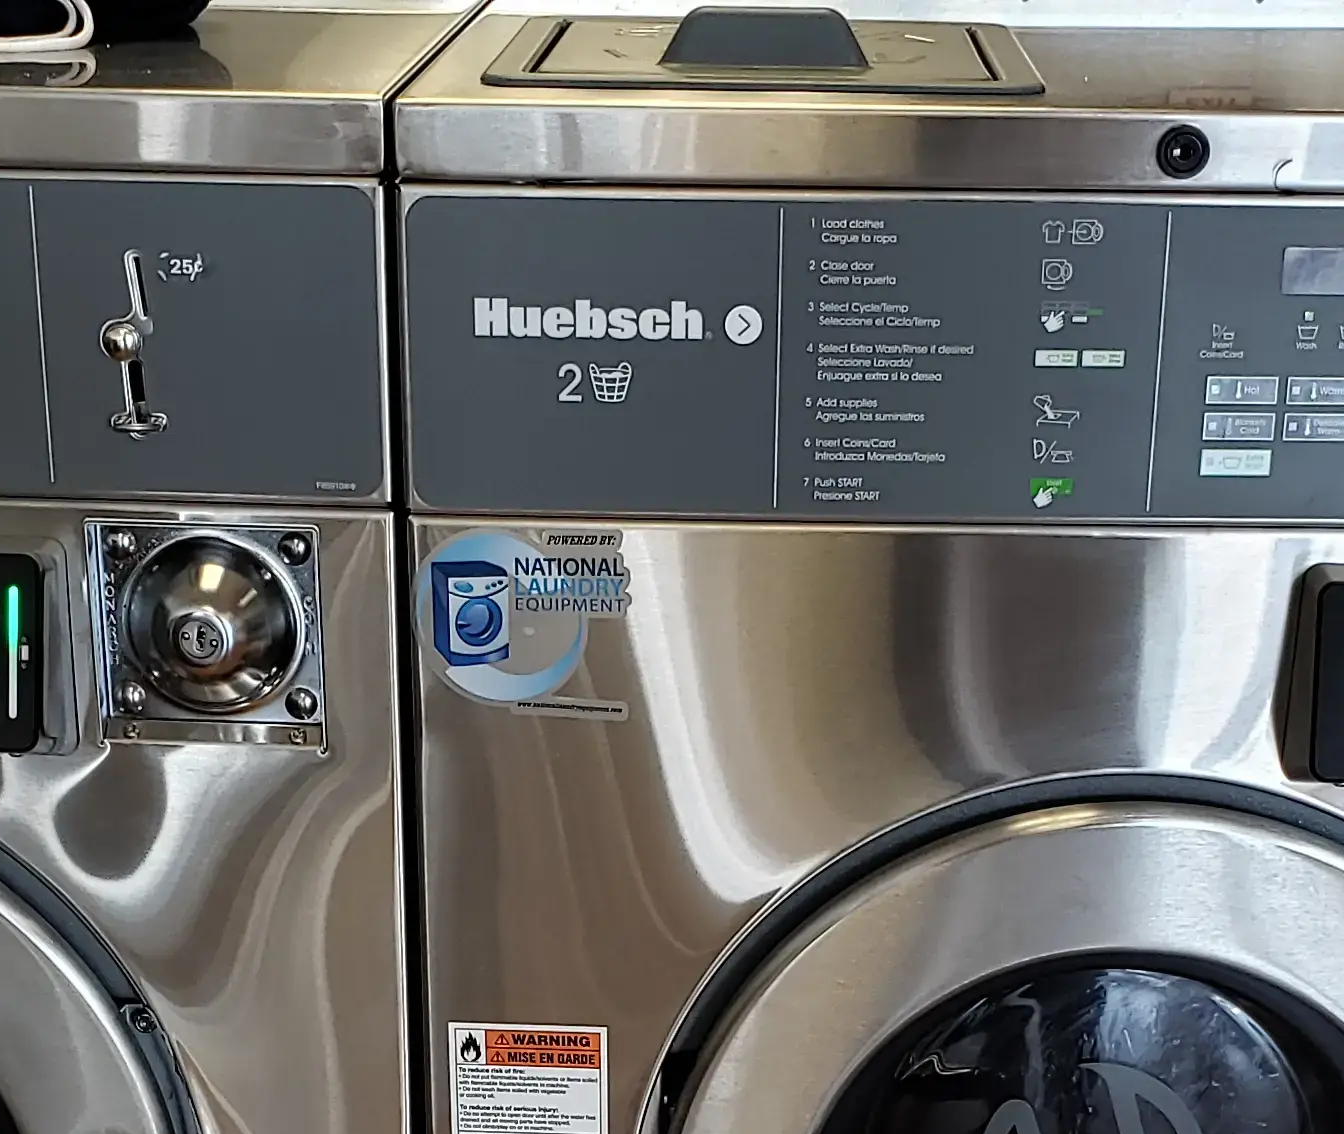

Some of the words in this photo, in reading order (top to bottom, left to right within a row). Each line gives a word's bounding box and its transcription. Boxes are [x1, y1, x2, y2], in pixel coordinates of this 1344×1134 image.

[822, 219, 847, 228] Load
[849, 220, 884, 229] clothes
[821, 233, 859, 244] Cargue
[862, 234, 871, 242] la
[873, 234, 897, 244] ropa
[809, 260, 815, 270] 2
[820, 261, 848, 270] Close
[850, 261, 874, 271] door
[820, 274, 849, 285] Cierre
[852, 275, 861, 284] la
[864, 275, 896, 286] puerta
[808, 302, 814, 311] 3
[819, 302, 849, 312] Select
[851, 303, 908, 313] Cycle/Temp
[473, 297, 703, 340] Huebsch
[819, 316, 873, 326] Seleccione
[875, 317, 884, 326] el
[886, 317, 940, 328] Ciclo/Temp
[807, 343, 813, 352] 4
[818, 343, 848, 353] Select
[850, 344, 873, 354] Extra
[875, 344, 928, 354] Wash/Rinse
[930, 345, 936, 354] if
[938, 345, 974, 354] desired
[1296, 342, 1317, 350] Wash
[818, 358, 871, 367] Seleccione
[817, 371, 862, 382] Enjuague
[865, 372, 889, 381] extra
[900, 372, 909, 381] lo
[911, 372, 942, 381] desea
[557, 363, 583, 402] 2
[1244, 386, 1260, 395] Hot
[805, 397, 812, 406] 5
[816, 398, 837, 407] Add
[839, 398, 877, 408] supplies
[816, 411, 857, 422] Agregue
[875, 412, 925, 421] suministros
[804, 438, 811, 447] 6
[816, 438, 840, 447] Insert
[842, 439, 896, 448] Coins/Card
[815, 452, 865, 461] Introduzca
[867, 452, 945, 463] Monedas/Tarjeta
[804, 478, 809, 486] 7
[815, 478, 835, 487] Push
[838, 478, 863, 487] START
[814, 491, 852, 500] Presione
[855, 491, 880, 501] START
[546, 535, 597, 546] POWERED
[599, 536, 617, 546] BY:
[514, 557, 624, 577] NATIONAL
[514, 577, 623, 596] LAUNDRY
[515, 597, 625, 613] EQUIPMENT
[511, 1033, 591, 1048] WARNING
[507, 1051, 536, 1064] MISE
[539, 1052, 555, 1064] EN
[557, 1053, 596, 1065] GARDE
